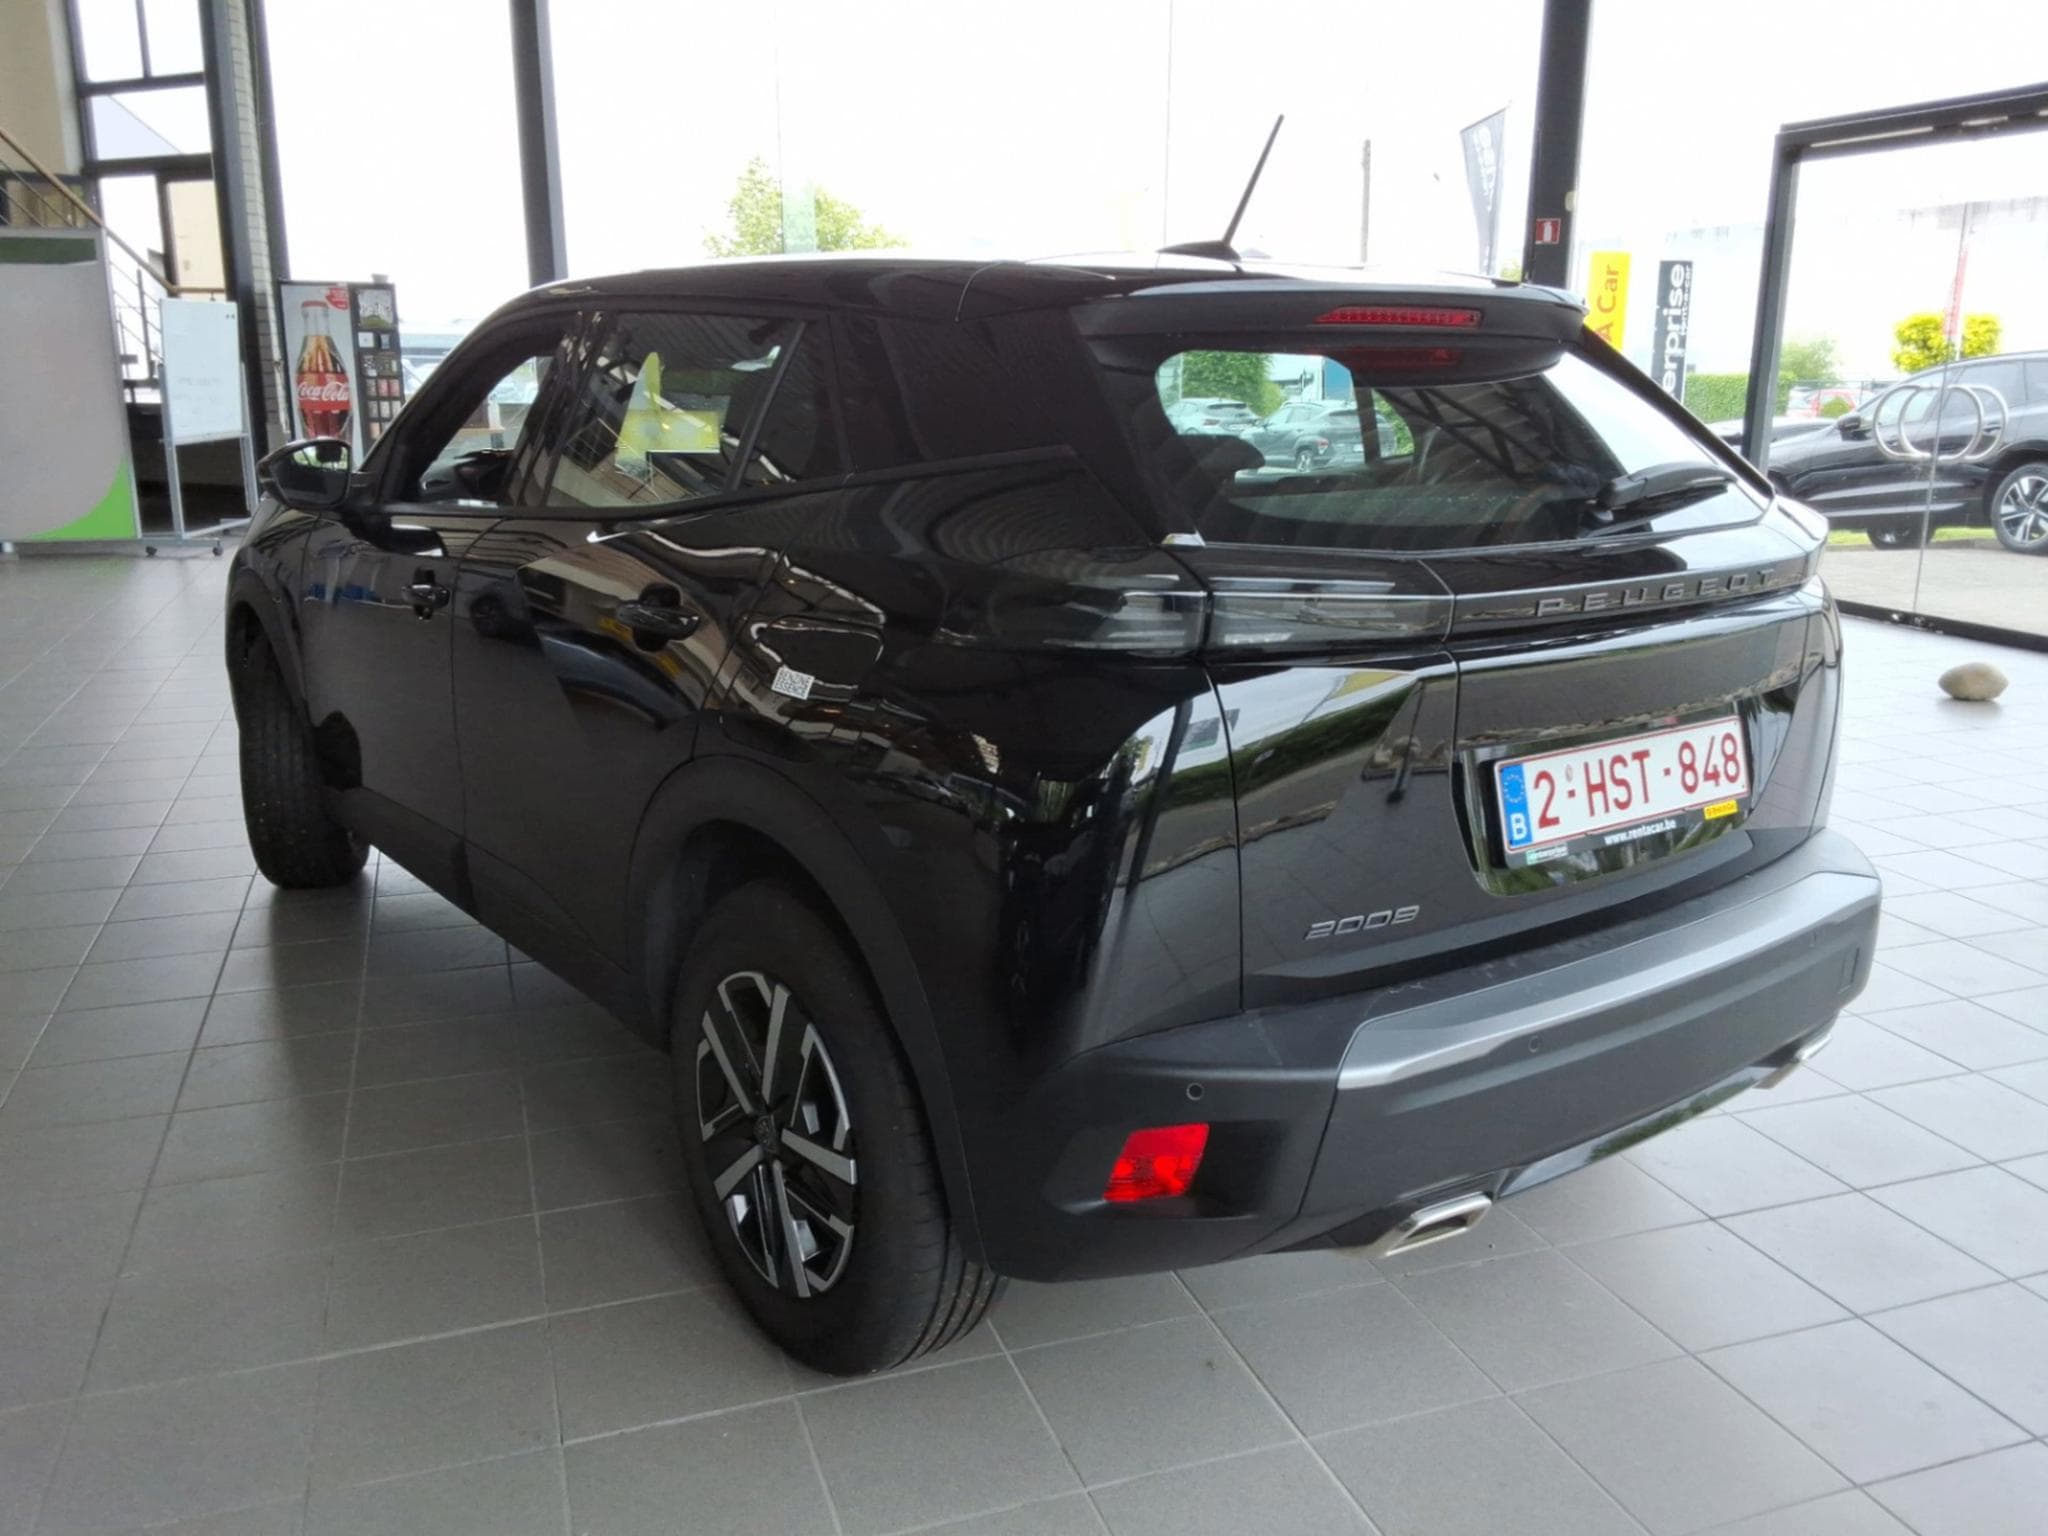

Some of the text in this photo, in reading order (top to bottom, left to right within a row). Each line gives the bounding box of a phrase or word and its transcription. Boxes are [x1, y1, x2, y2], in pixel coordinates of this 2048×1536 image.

[1596, 264, 1619, 314] Car
[1662, 264, 1686, 394] erprise
[1534, 568, 1775, 617] PEUGEOT
[1533, 732, 1740, 829] 2-HST-848
[1509, 812, 1529, 841] B
[1303, 904, 1420, 941] 2008
